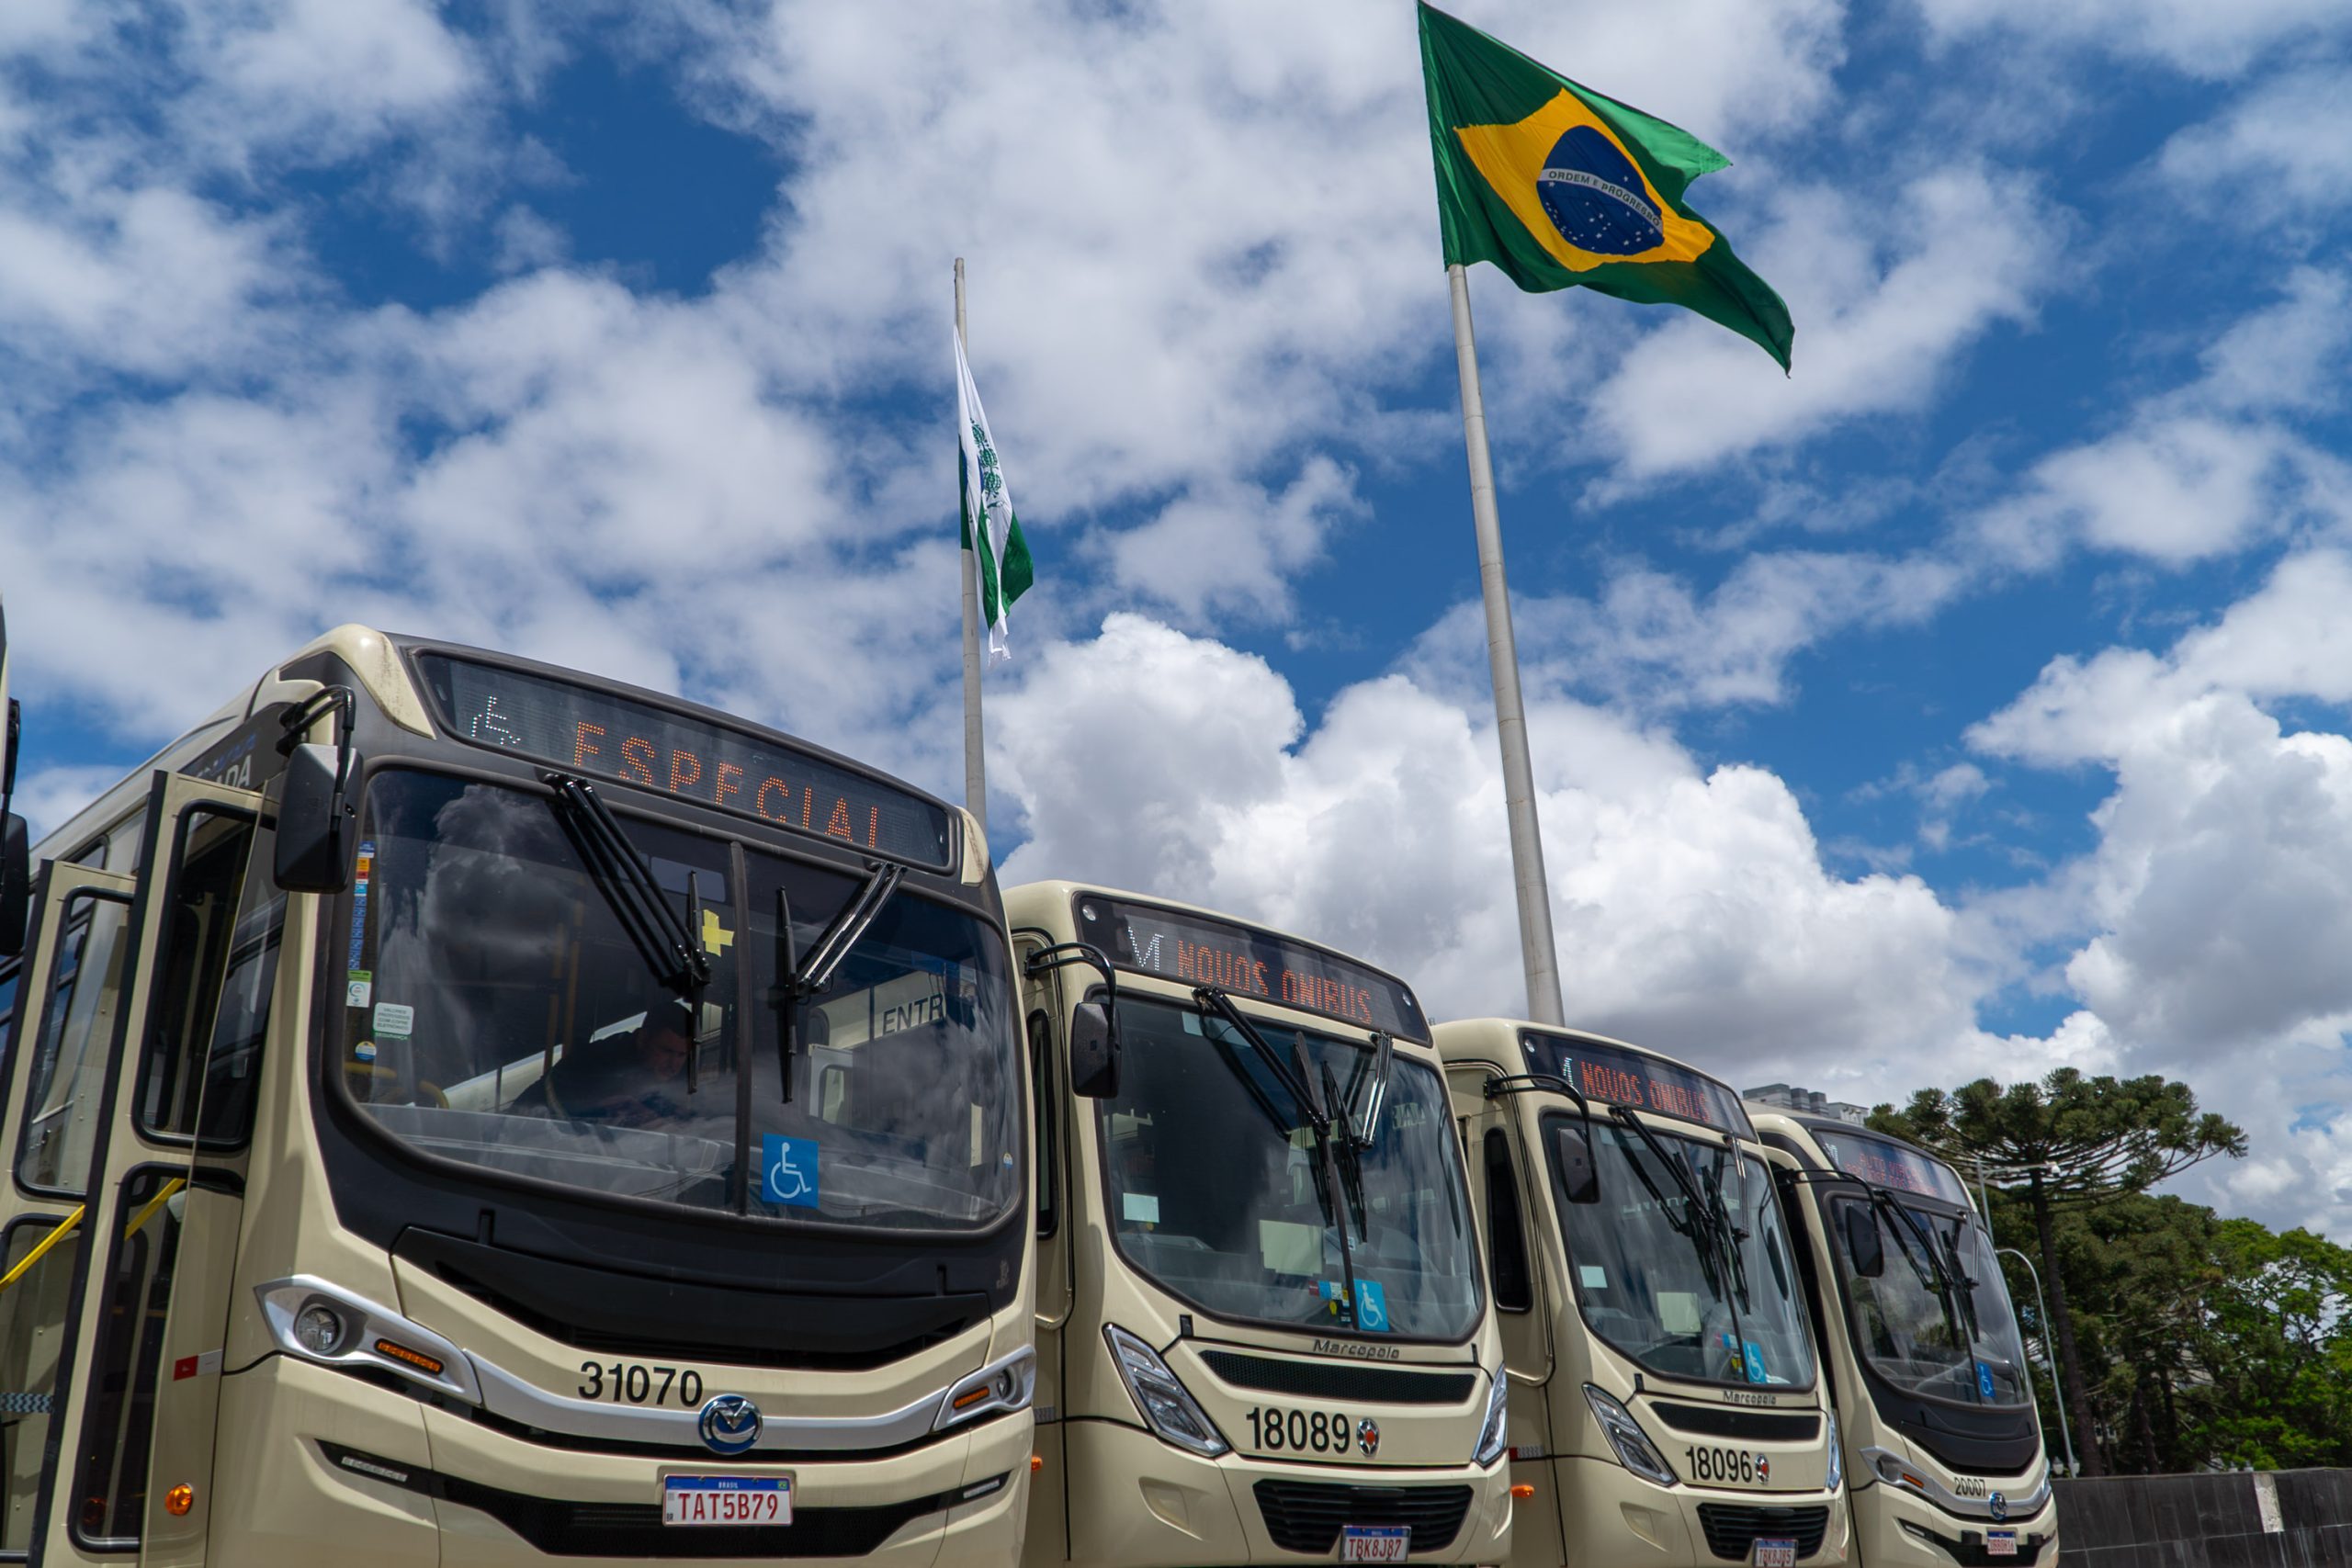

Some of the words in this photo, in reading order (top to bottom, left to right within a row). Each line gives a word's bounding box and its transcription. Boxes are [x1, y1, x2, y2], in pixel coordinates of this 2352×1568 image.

[1548, 170, 1589, 185] ORDEM
[1600, 183, 1660, 227] PROGRESSO
[1580, 1061, 1645, 1106] NOVOS
[1313, 1338, 1400, 1359] Marcopolo
[578, 1360, 704, 1408] 31070
[1723, 1389, 1777, 1405] Marcopolo
[1246, 1406, 1351, 1454] 18089
[1685, 1446, 1753, 1483] 18096
[678, 1493, 778, 1520] TAT5B79
[1349, 1539, 1402, 1558] TBK8J87
